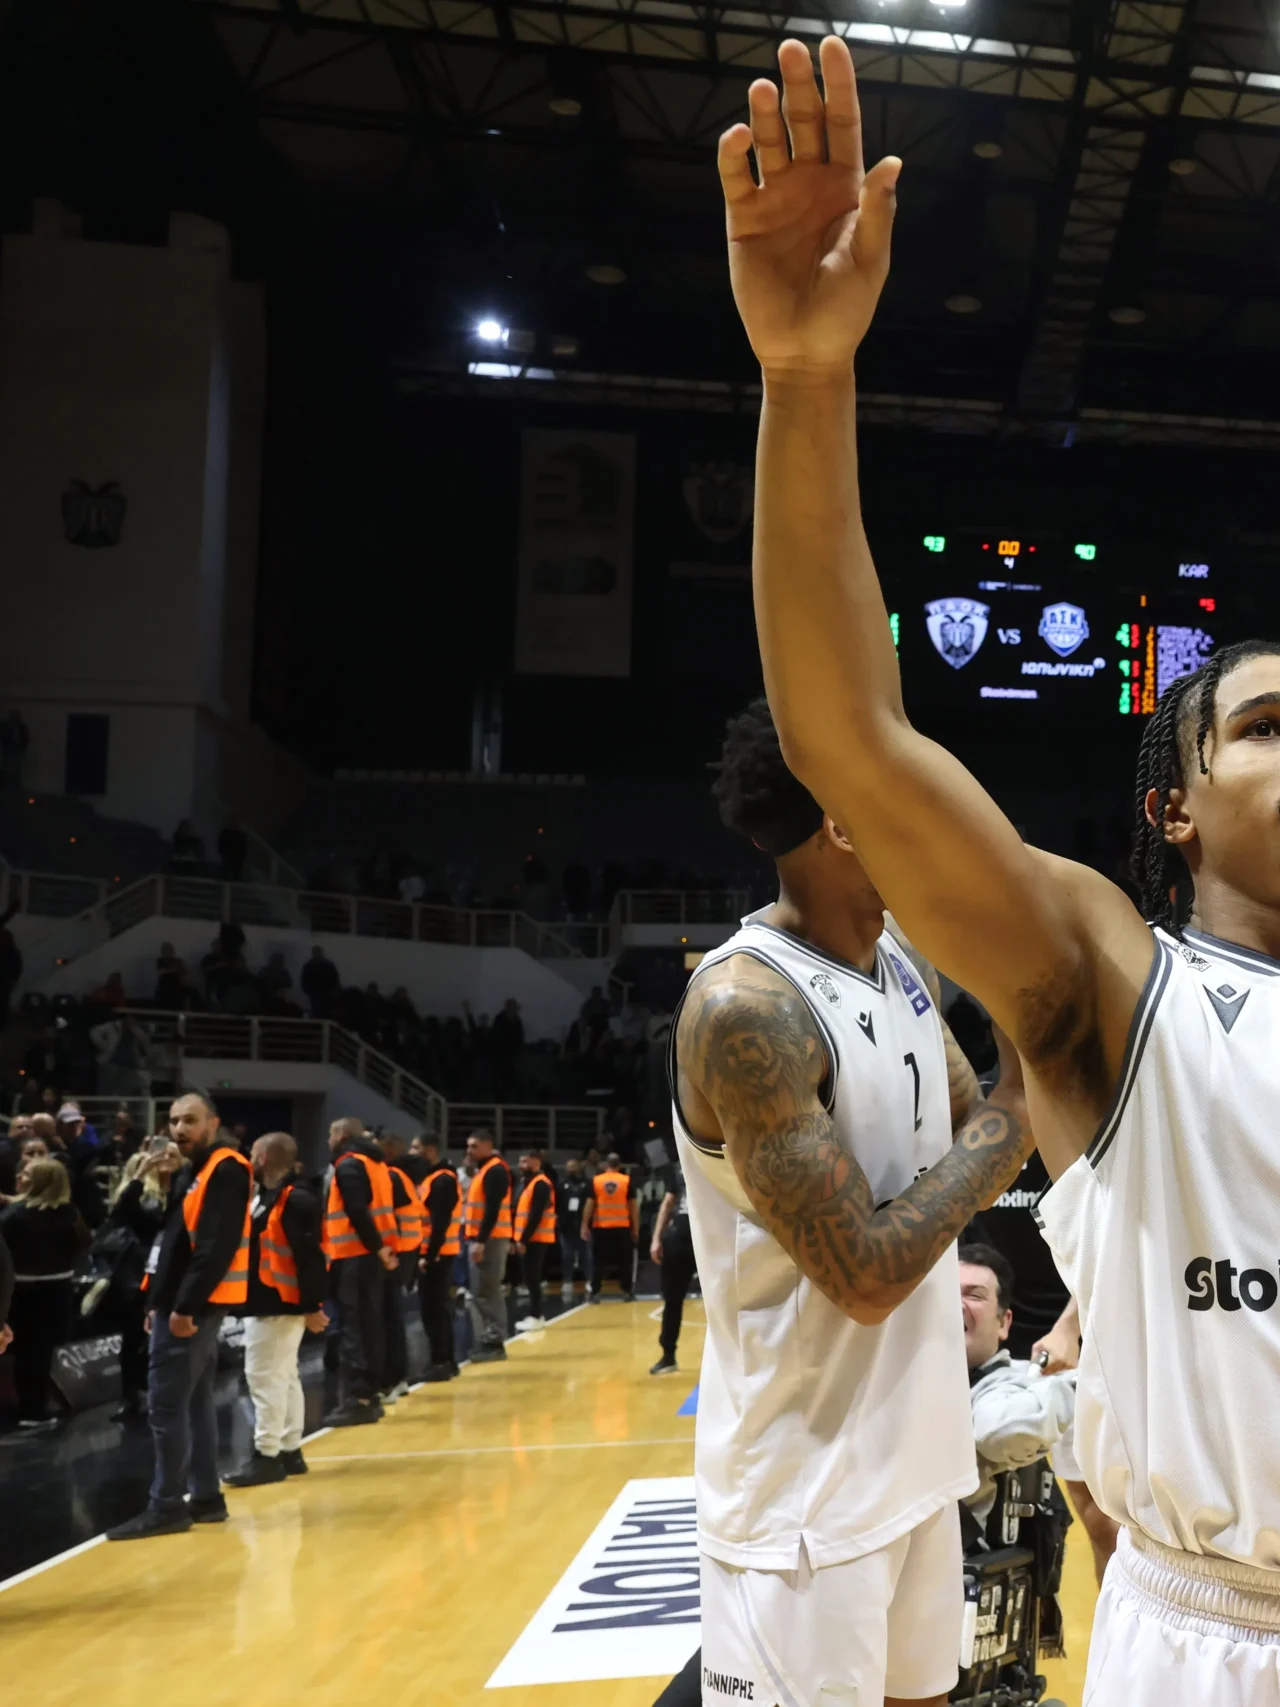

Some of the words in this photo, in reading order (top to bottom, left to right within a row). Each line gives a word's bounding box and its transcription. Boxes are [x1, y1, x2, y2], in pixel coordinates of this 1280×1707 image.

[923, 535, 945, 552] 93
[998, 540, 1020, 555] 00
[1074, 544, 1096, 560] 90
[1178, 563, 1209, 578] KAR
[997, 628, 1021, 645] VS
